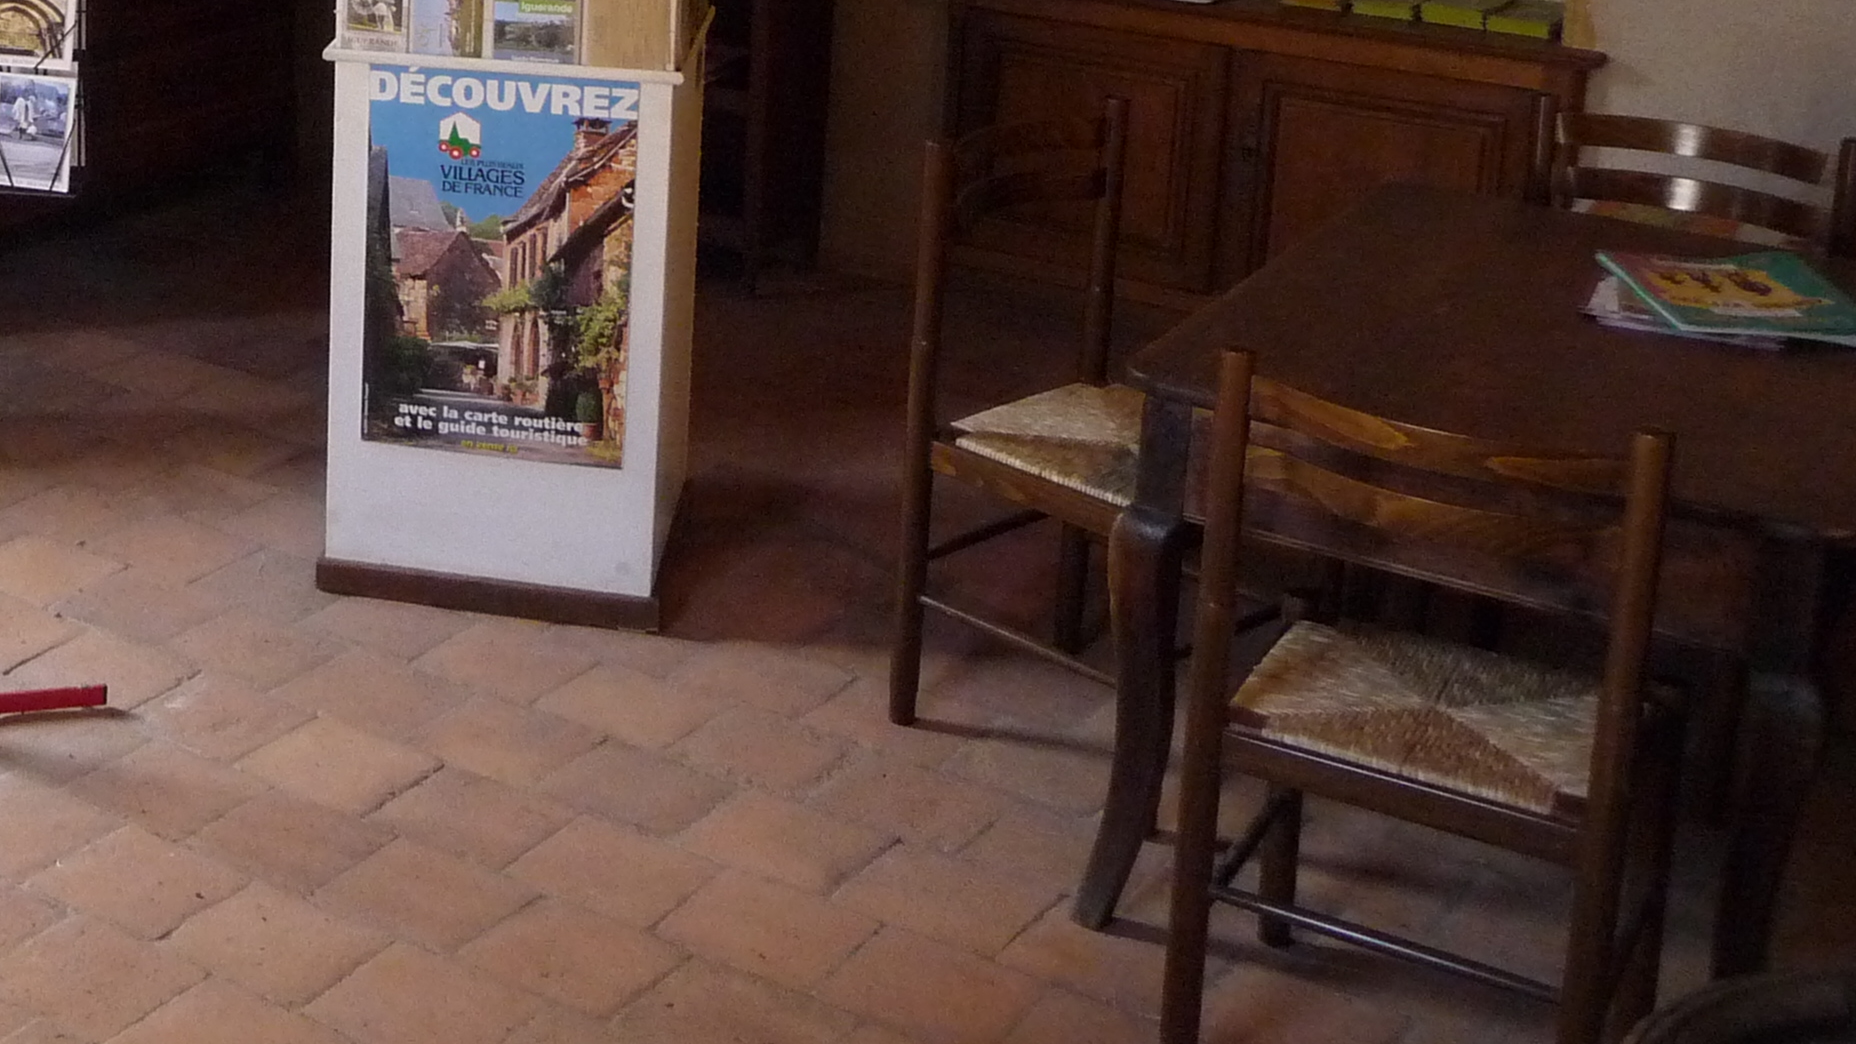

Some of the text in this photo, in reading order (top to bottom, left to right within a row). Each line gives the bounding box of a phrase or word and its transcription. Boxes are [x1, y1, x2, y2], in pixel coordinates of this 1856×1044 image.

[521, 1, 573, 14] Iguerande
[370, 66, 639, 120] DÉCOUVREZ
[440, 164, 525, 186] VILLAGES
[442, 180, 524, 199] DE FRANCE
[394, 414, 589, 447] et le guide touristique
[398, 403, 584, 434] avec la carte routière
